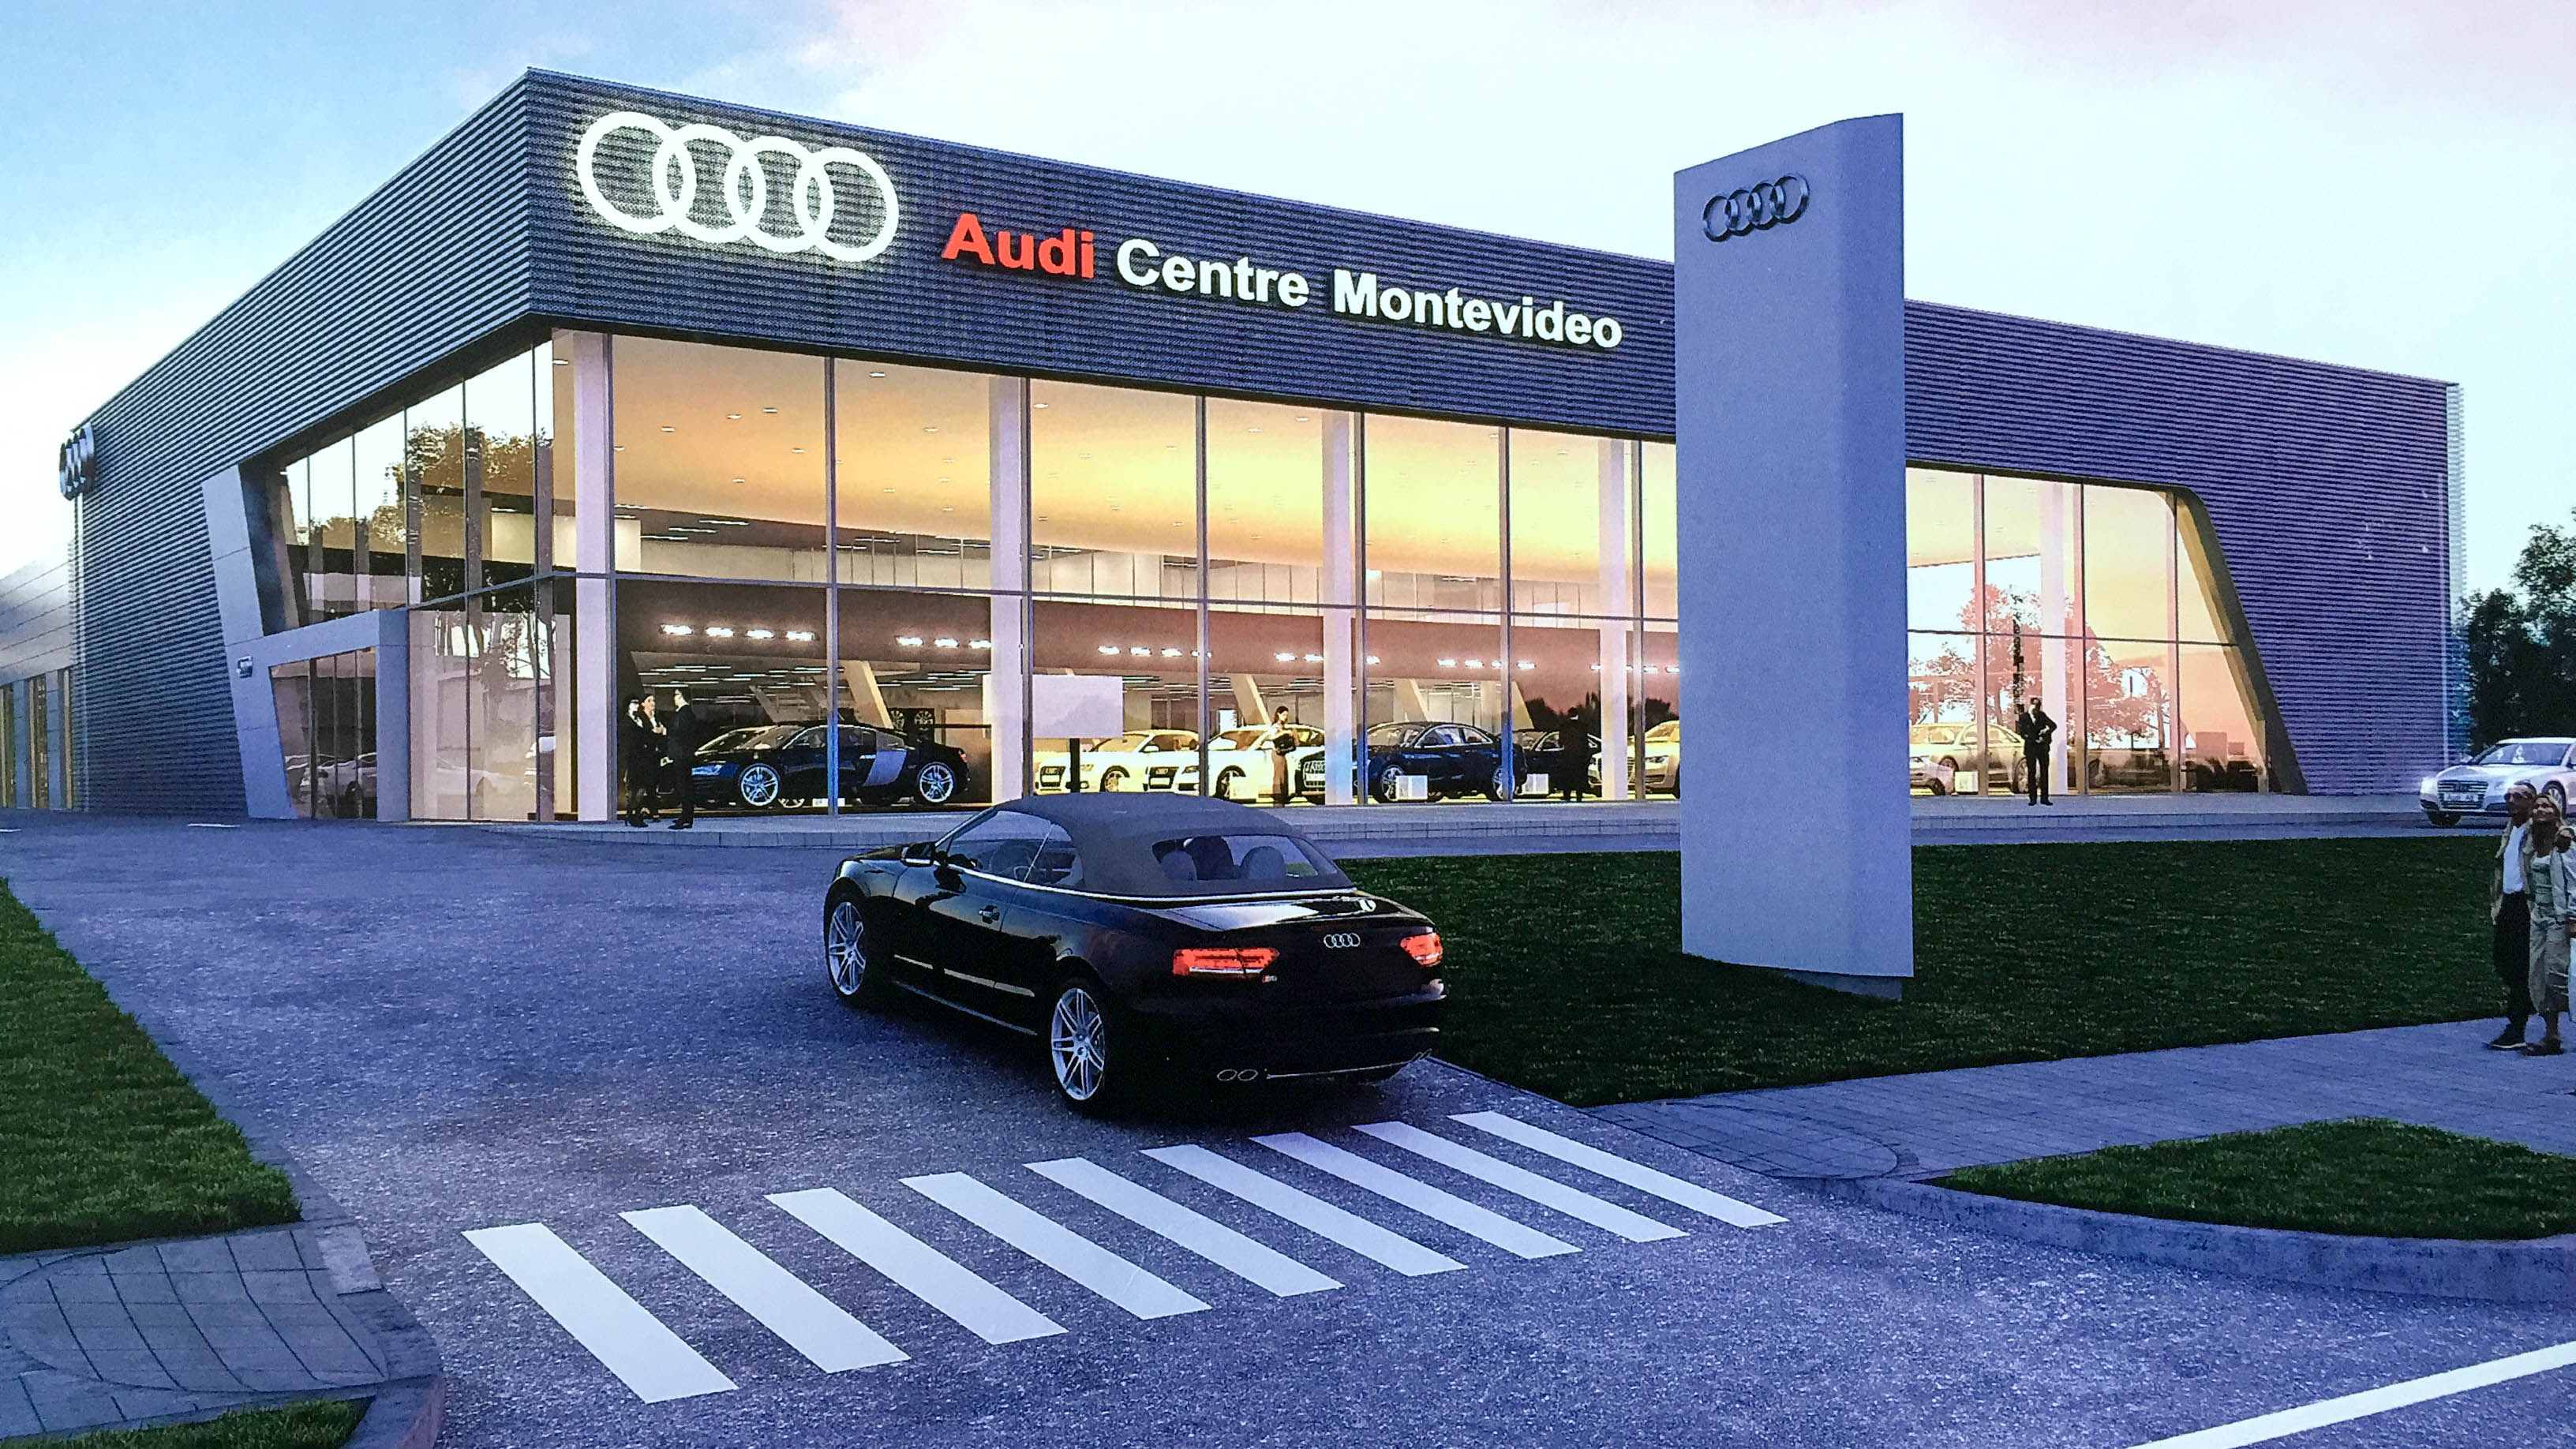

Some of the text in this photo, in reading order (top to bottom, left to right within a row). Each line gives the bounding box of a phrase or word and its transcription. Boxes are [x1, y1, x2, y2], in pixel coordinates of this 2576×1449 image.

[942, 213, 1623, 348] Audi Centre Montevideo
